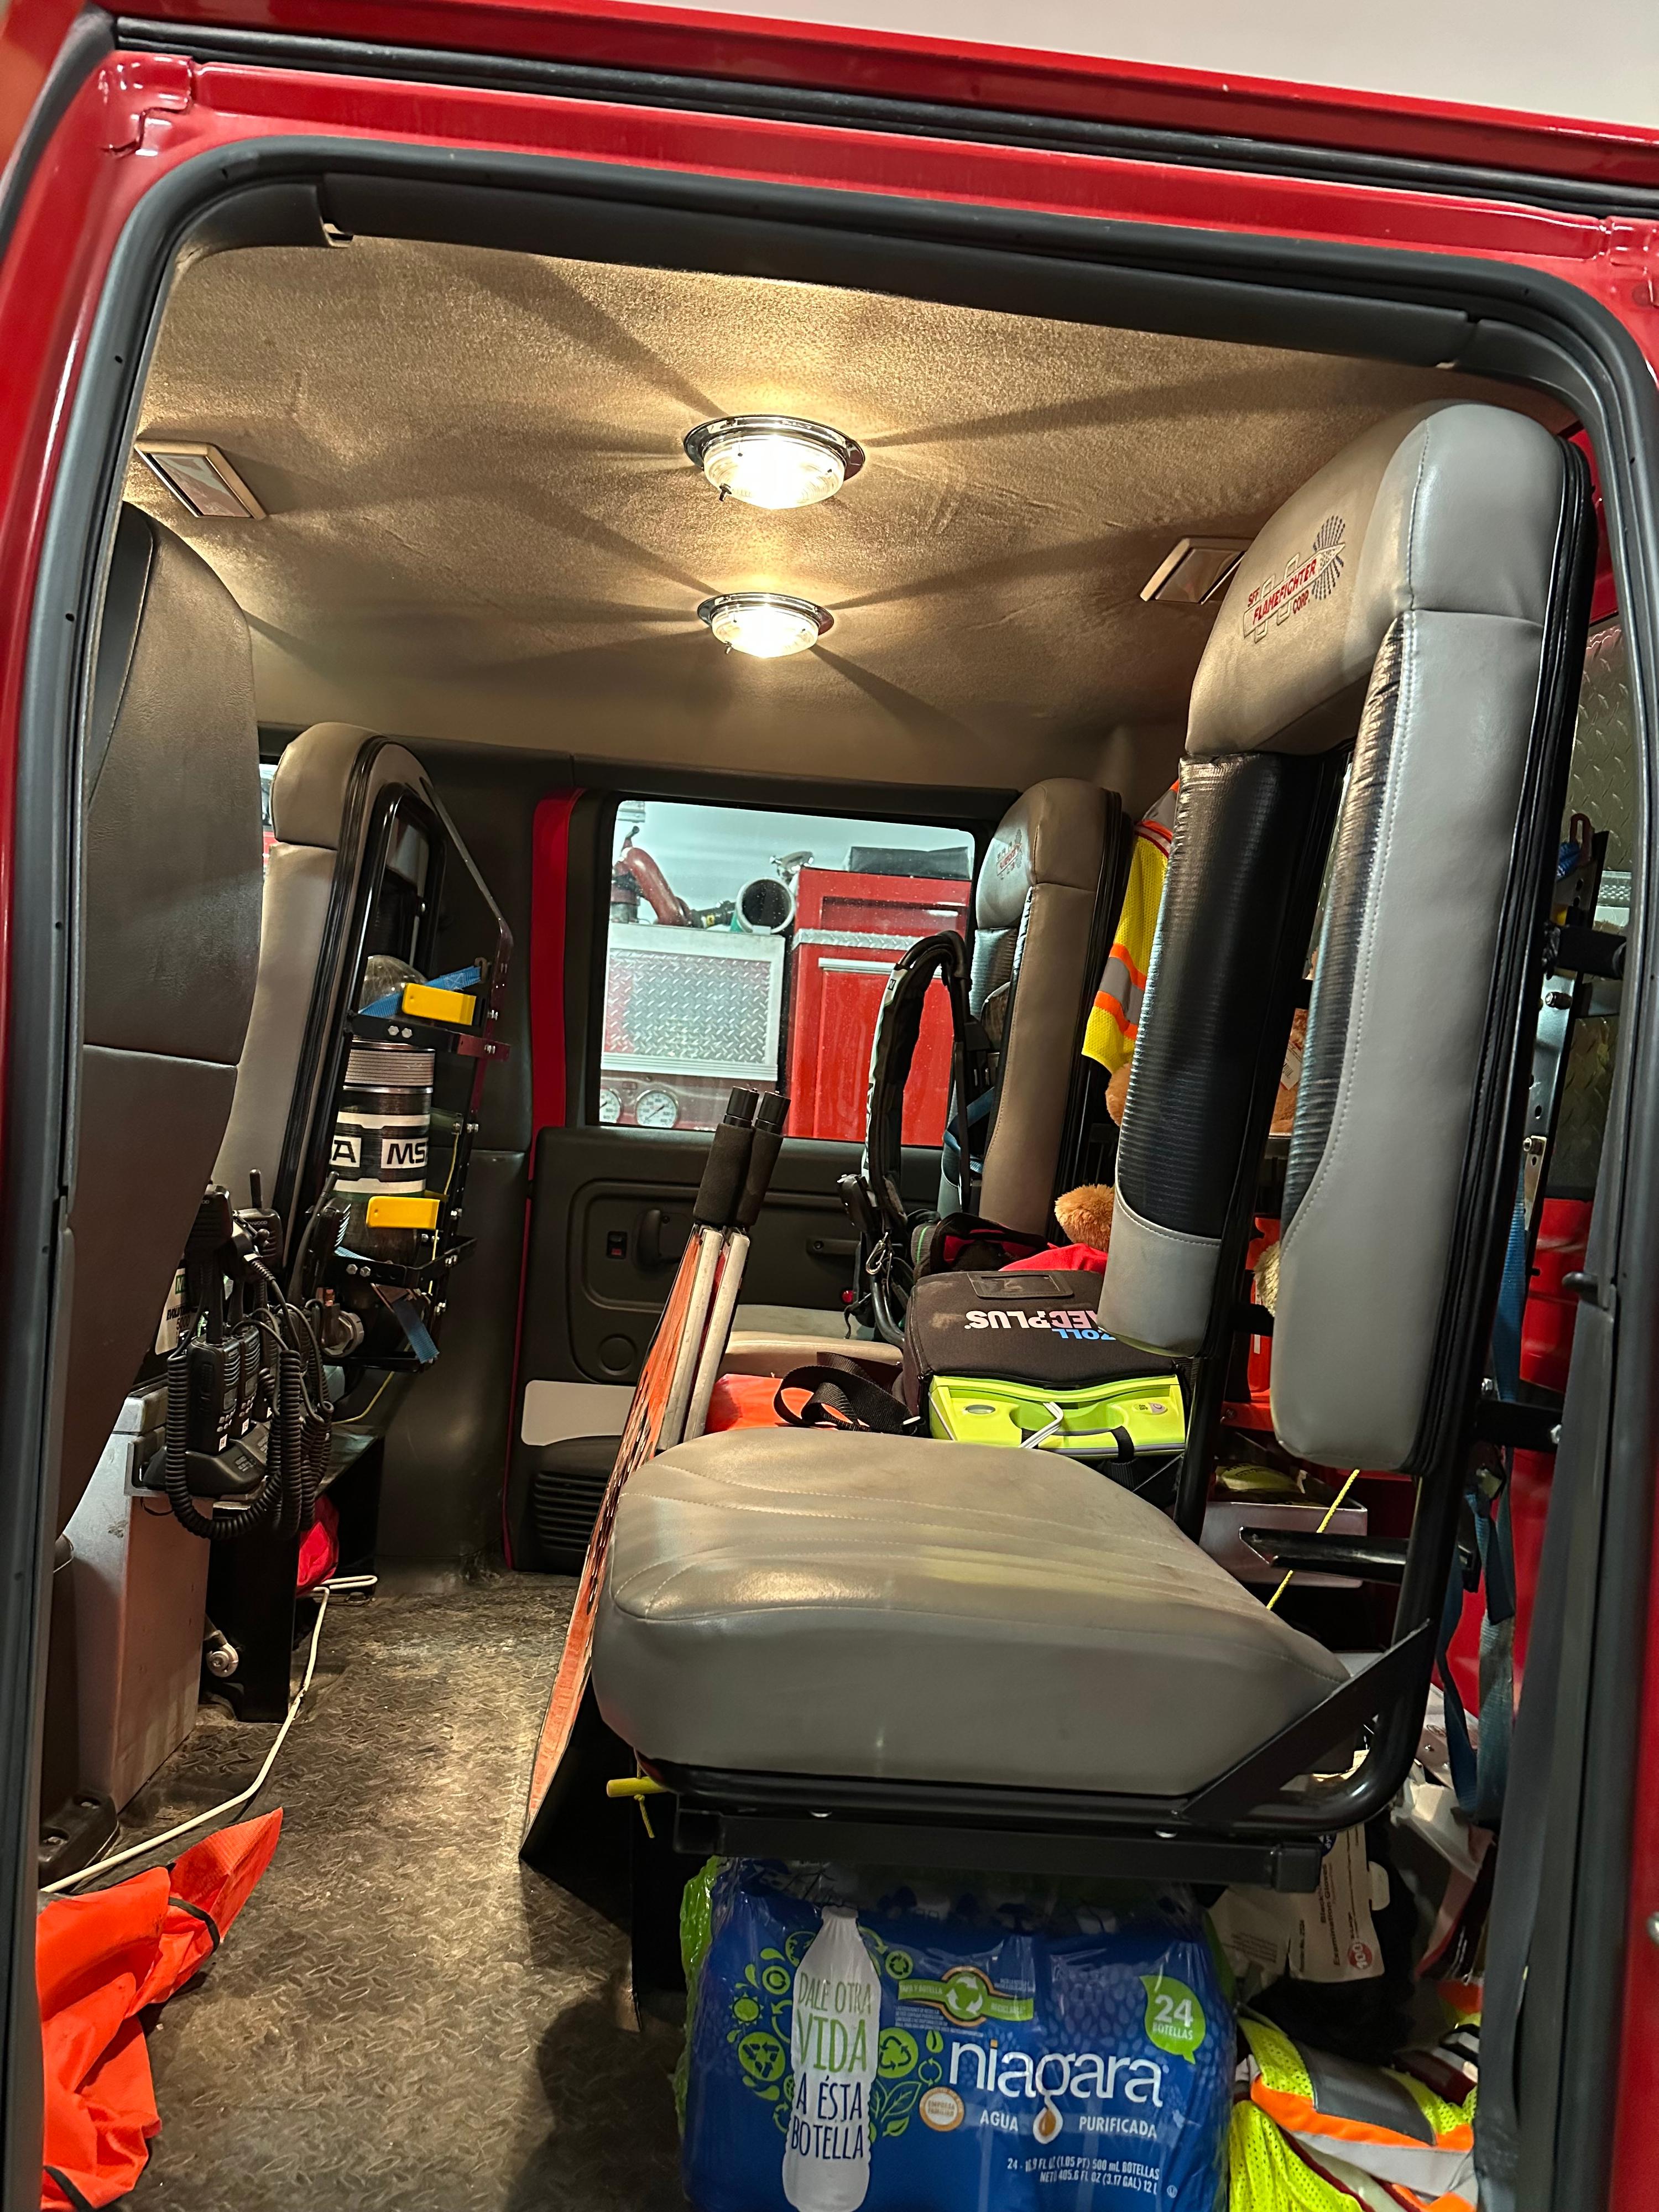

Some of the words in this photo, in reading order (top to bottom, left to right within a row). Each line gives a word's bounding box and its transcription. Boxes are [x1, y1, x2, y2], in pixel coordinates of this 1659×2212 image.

[1253, 559, 1316, 625] FLAMEFIGHTER
[387, 1142, 427, 1165] MS
[1327, 1902, 1340, 1965] Examination
[798, 1972, 831, 2011] DALE
[835, 1981, 871, 2014] OTRA
[1155, 1994, 1193, 2027] 24
[797, 2008, 867, 2073] VIDA
[1152, 2022, 1193, 2040] BOTELLAS
[796, 2072, 807, 2115] A
[818, 2075, 862, 2122] ÉSTA
[949, 2039, 1163, 2144] niagara
[791, 2115, 864, 2159] BOTELLA
[980, 2110, 1019, 2132] AGUA
[1079, 2116, 1157, 2140] PURIFICADA
[1007, 2158, 1018, 2170] 24
[1092, 2159, 1107, 2171] 500
[1122, 2161, 1160, 2180] BOTELLAS
